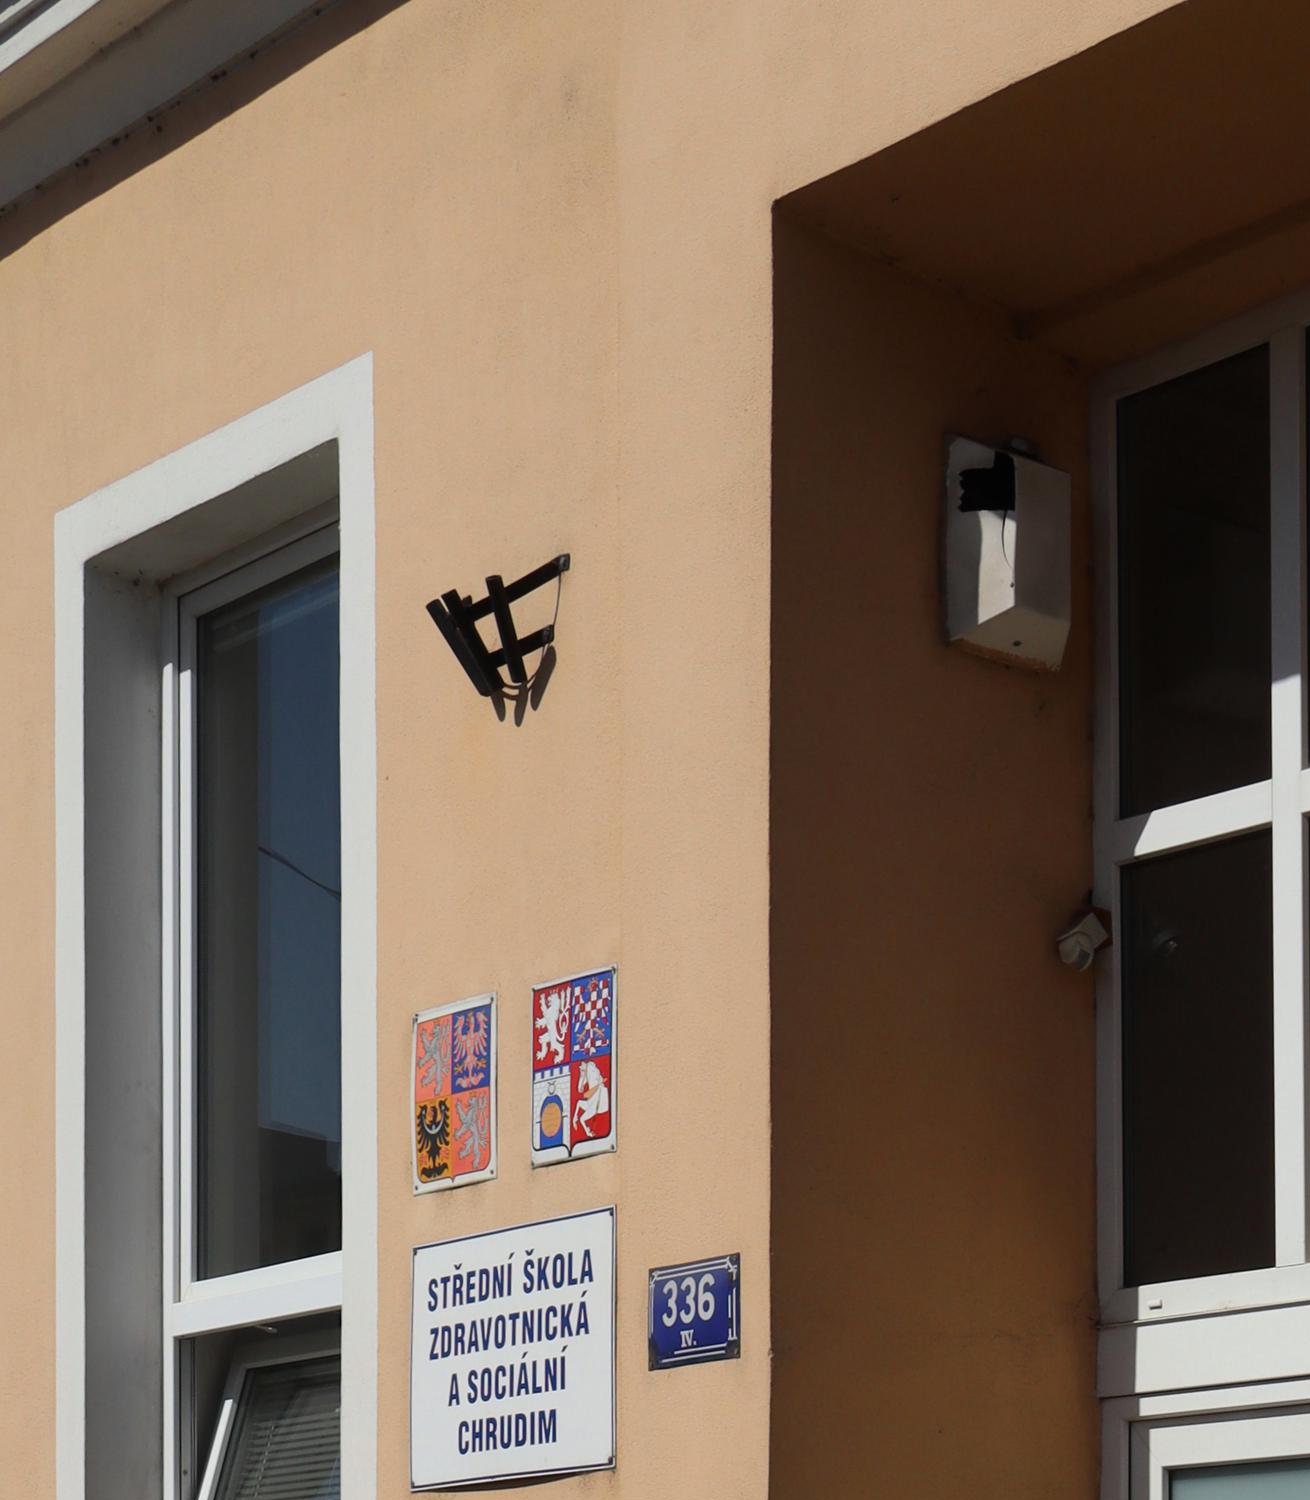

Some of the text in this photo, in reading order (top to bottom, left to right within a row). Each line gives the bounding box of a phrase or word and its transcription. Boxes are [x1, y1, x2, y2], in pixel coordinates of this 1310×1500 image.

[427, 1248, 594, 1313] STŘEDNÍ ŠKOLA
[661, 1272, 716, 1328] 336
[428, 1290, 590, 1361] ZDRAVOTNICKÁ
[680, 1329, 697, 1348] IV.
[448, 1345, 567, 1407] A SOCIÁLNÍ
[457, 1408, 557, 1455] CHRUDIM
